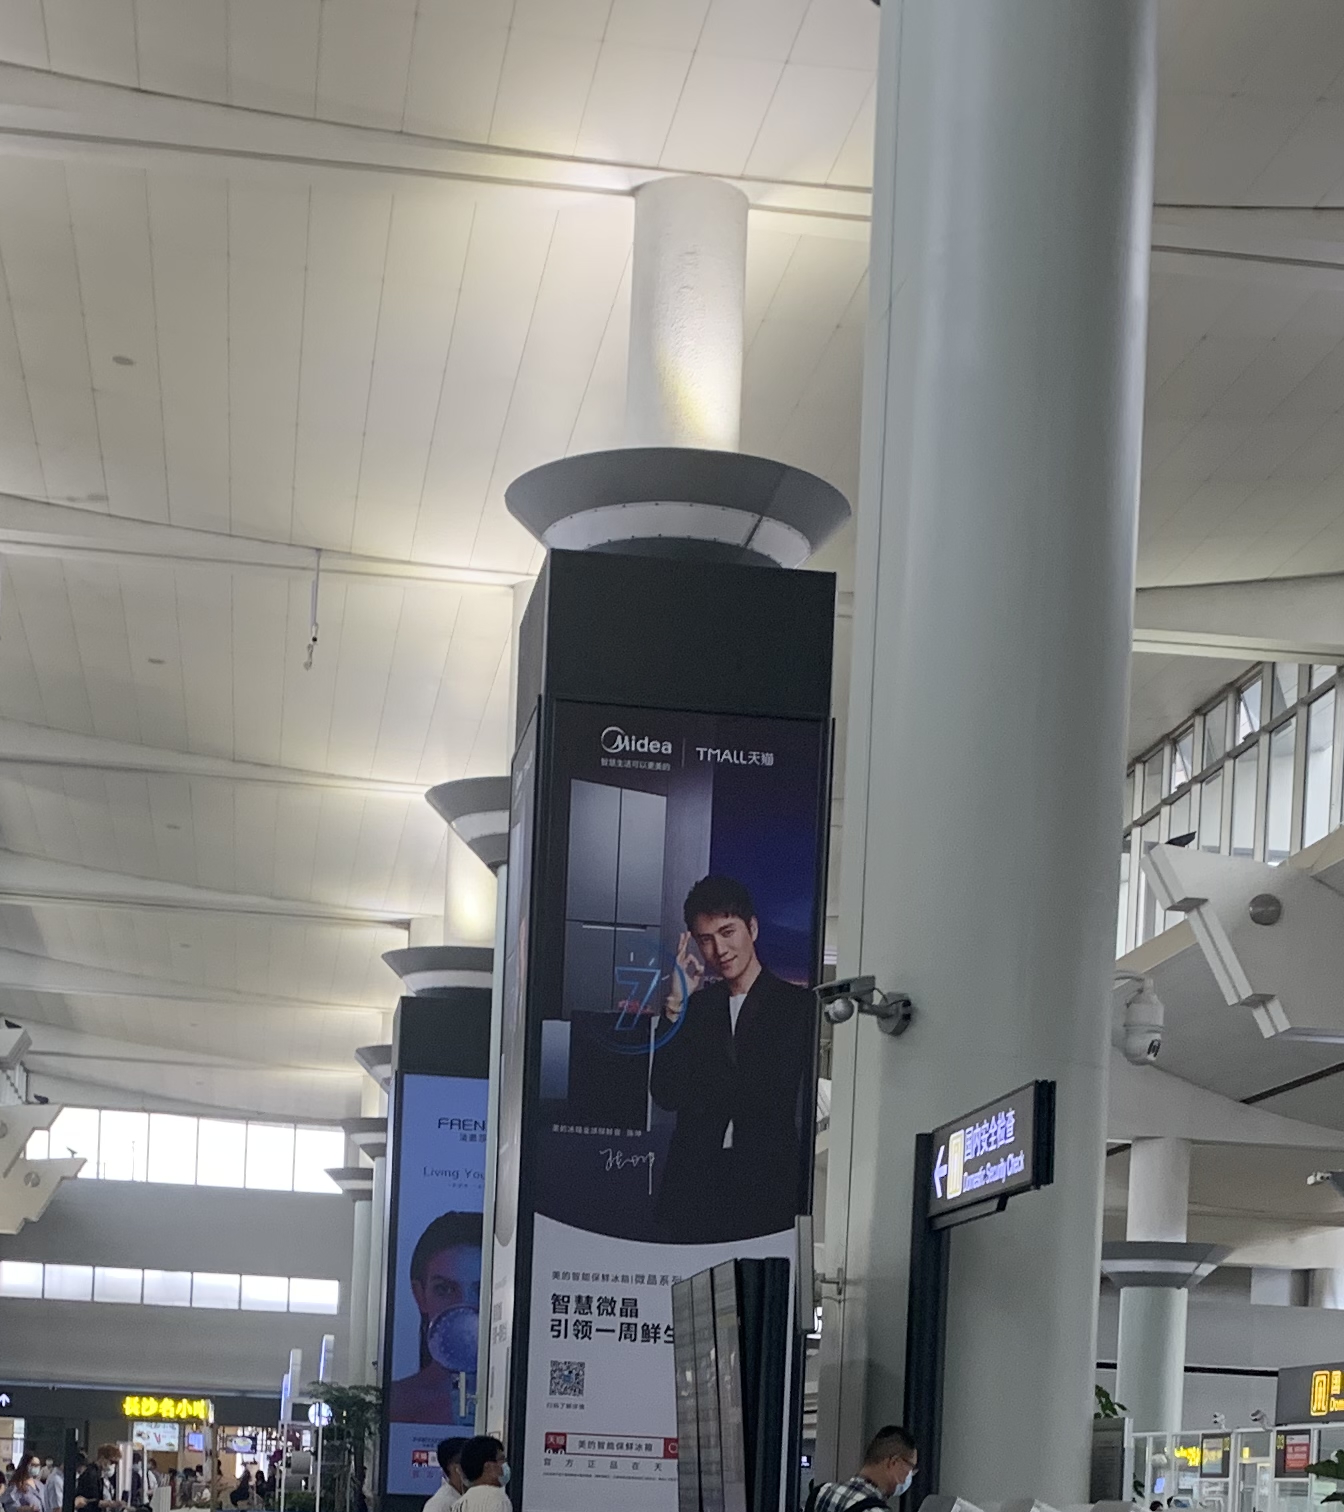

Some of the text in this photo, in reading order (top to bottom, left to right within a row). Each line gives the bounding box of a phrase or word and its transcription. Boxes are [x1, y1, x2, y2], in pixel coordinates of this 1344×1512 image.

[601, 726, 673, 754] Midea
[964, 1107, 1016, 1162] 国内安全检查
[423, 1166, 459, 1179] Living
[1006, 1150, 1025, 1176] Check
[551, 1293, 639, 1318] 智慧微晶
[578, 1439, 653, 1453] 美的智能保鲜冰箱
[543, 1457, 678, 1472] 官方正品在天
